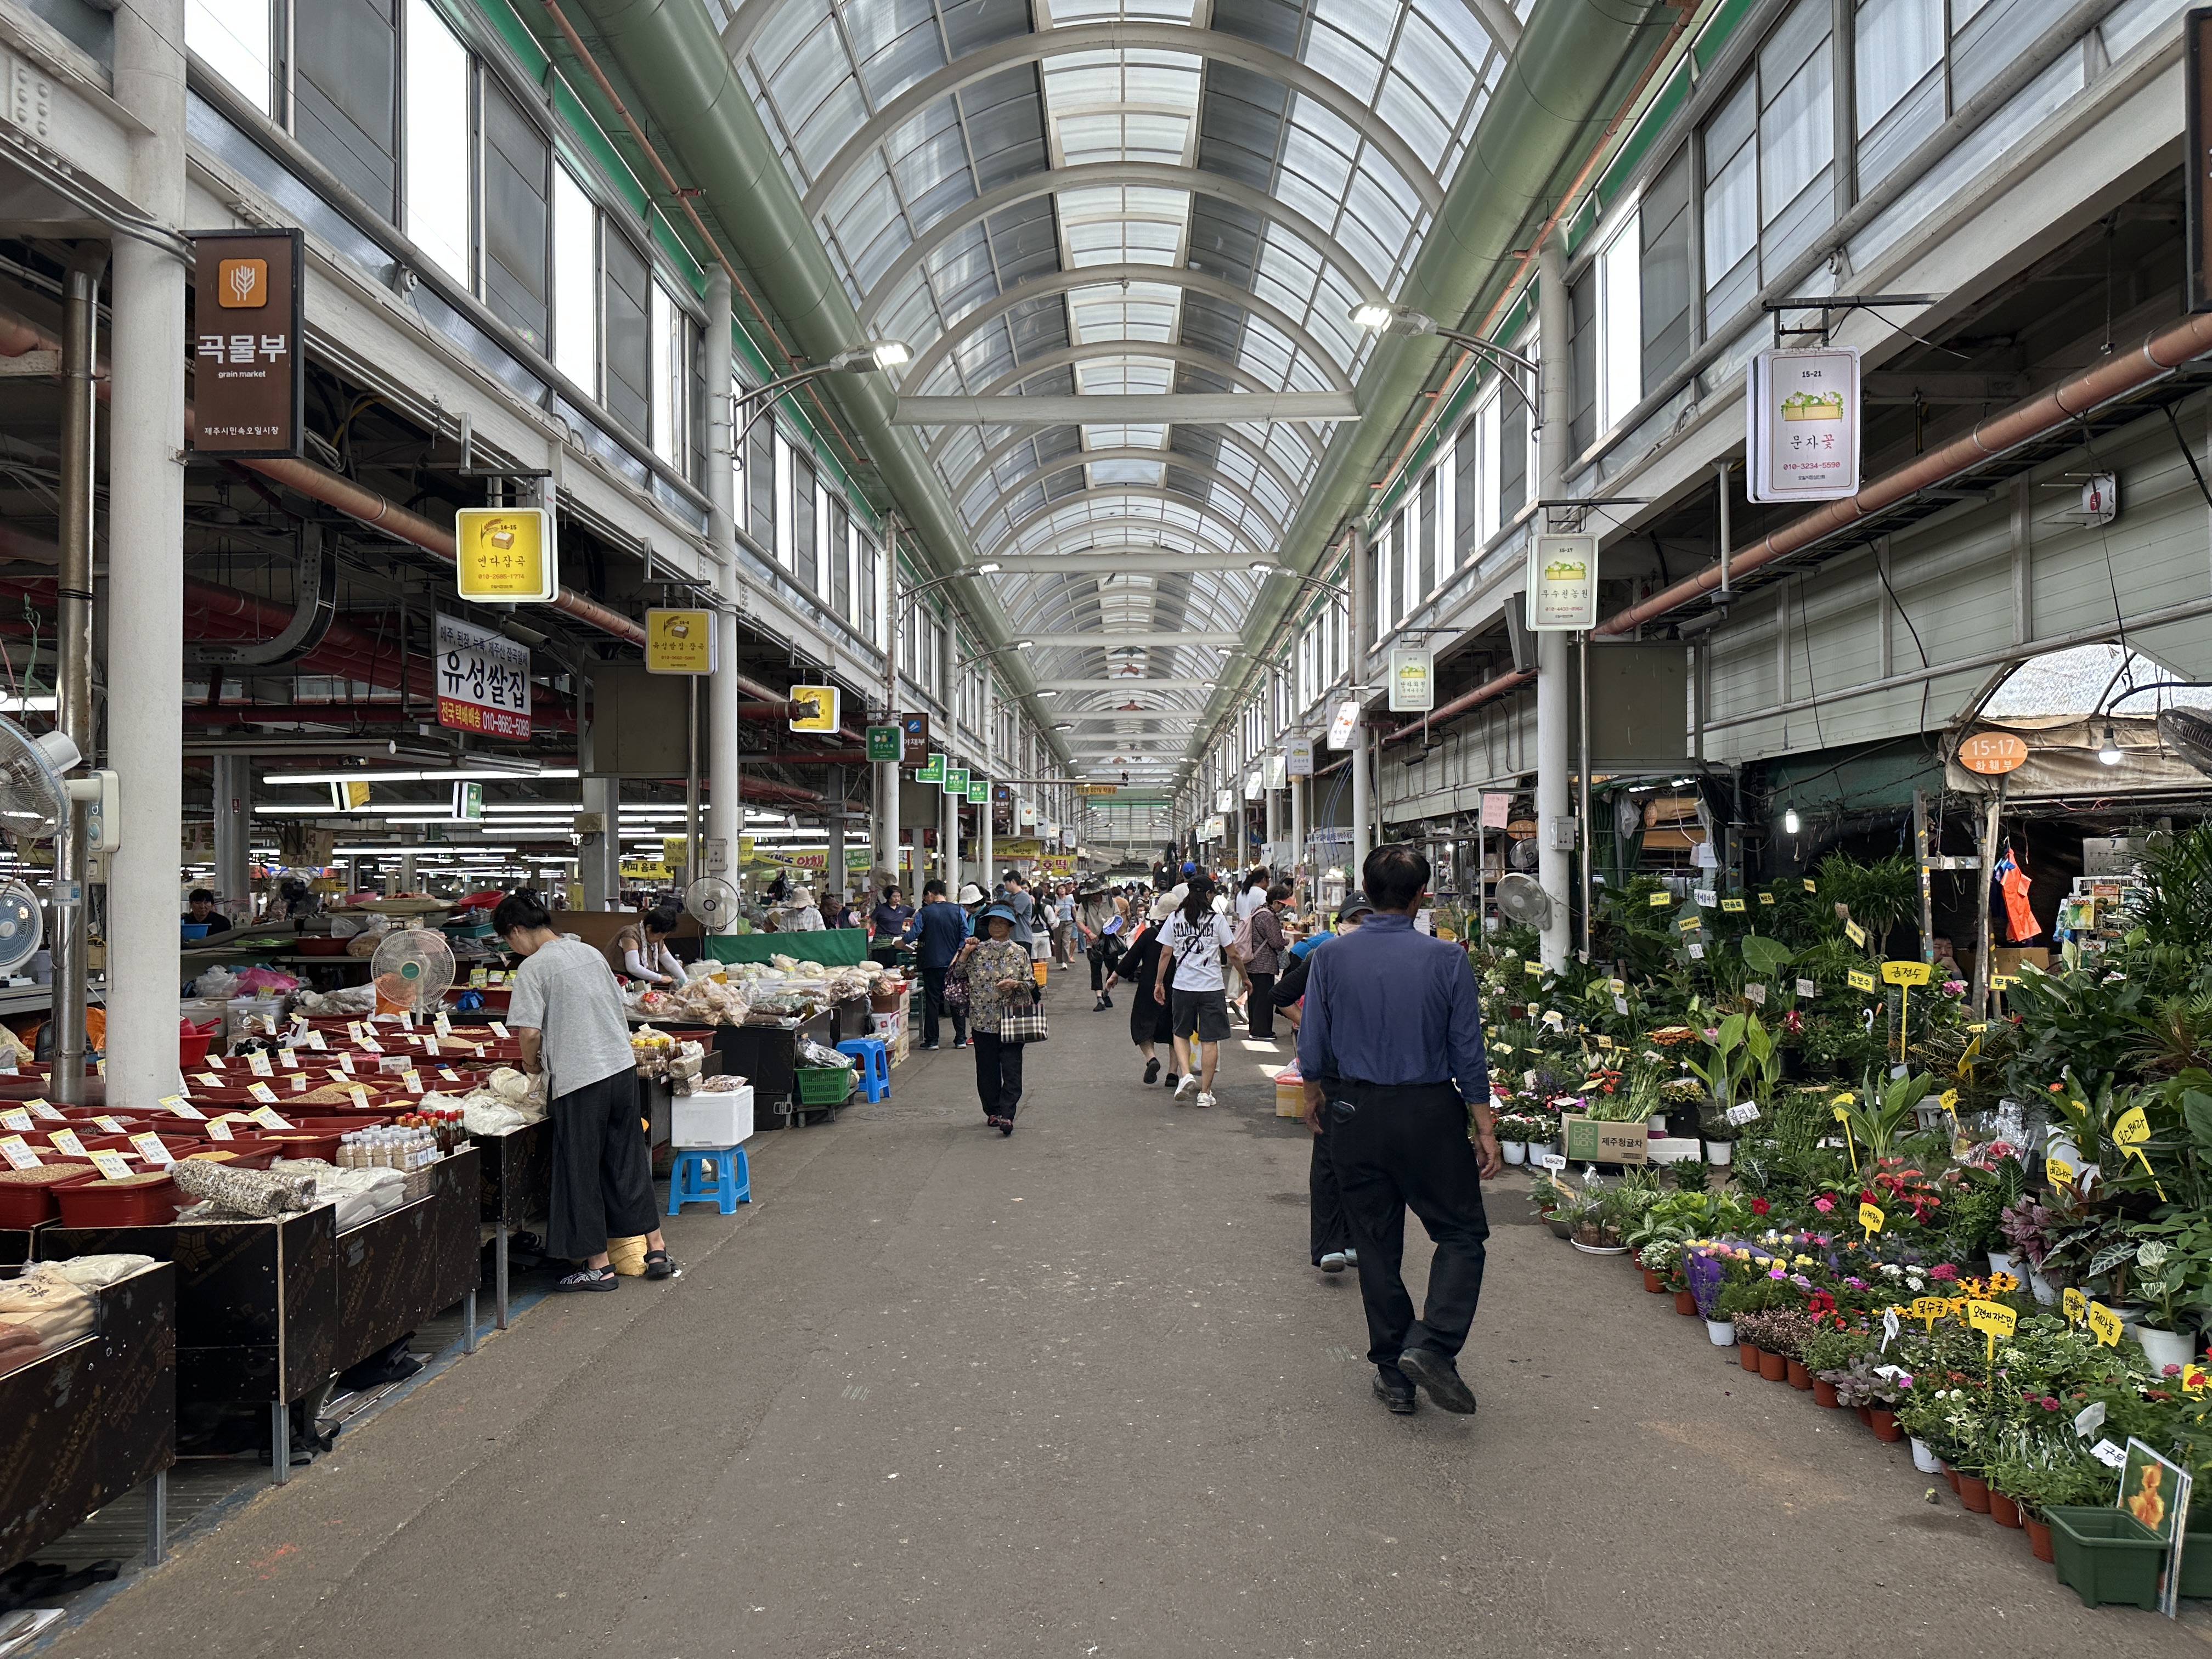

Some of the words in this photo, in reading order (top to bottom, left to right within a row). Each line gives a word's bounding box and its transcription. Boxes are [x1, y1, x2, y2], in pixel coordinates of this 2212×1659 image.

[197, 335, 287, 364] 곡물부
[218, 370, 238, 379] grain
[204, 426, 279, 436] 제주시민속오일시장
[478, 555, 526, 567] 엔다잡곡
[1541, 589, 1588, 599] 무수천농원
[442, 650, 525, 709] 유성쌀집
[441, 701, 455, 723] 전국
[455, 703, 481, 729] 택배배송
[482, 711, 529, 737] 010-8662-5089
[1972, 738, 2015, 757] 15-17
[1975, 759, 2014, 771] 화훼부
[2110, 840, 2116, 848] 7
[796, 854, 824, 866] 야채
[1042, 859, 1068, 871] 호떡
[622, 863, 638, 872] 커피
[641, 863, 658, 871] 음료
[1891, 966, 1922, 979] 금전수
[1850, 973, 1871, 988] 녹보수
[2118, 1118, 2146, 1144] 몬스테라
[1601, 1137, 1643, 1148] 제주청귤차
[1917, 1301, 1943, 1314] 목수국
[1973, 1305, 1991, 1319] 오렌지
[1993, 1312, 2014, 1328] 자스민
